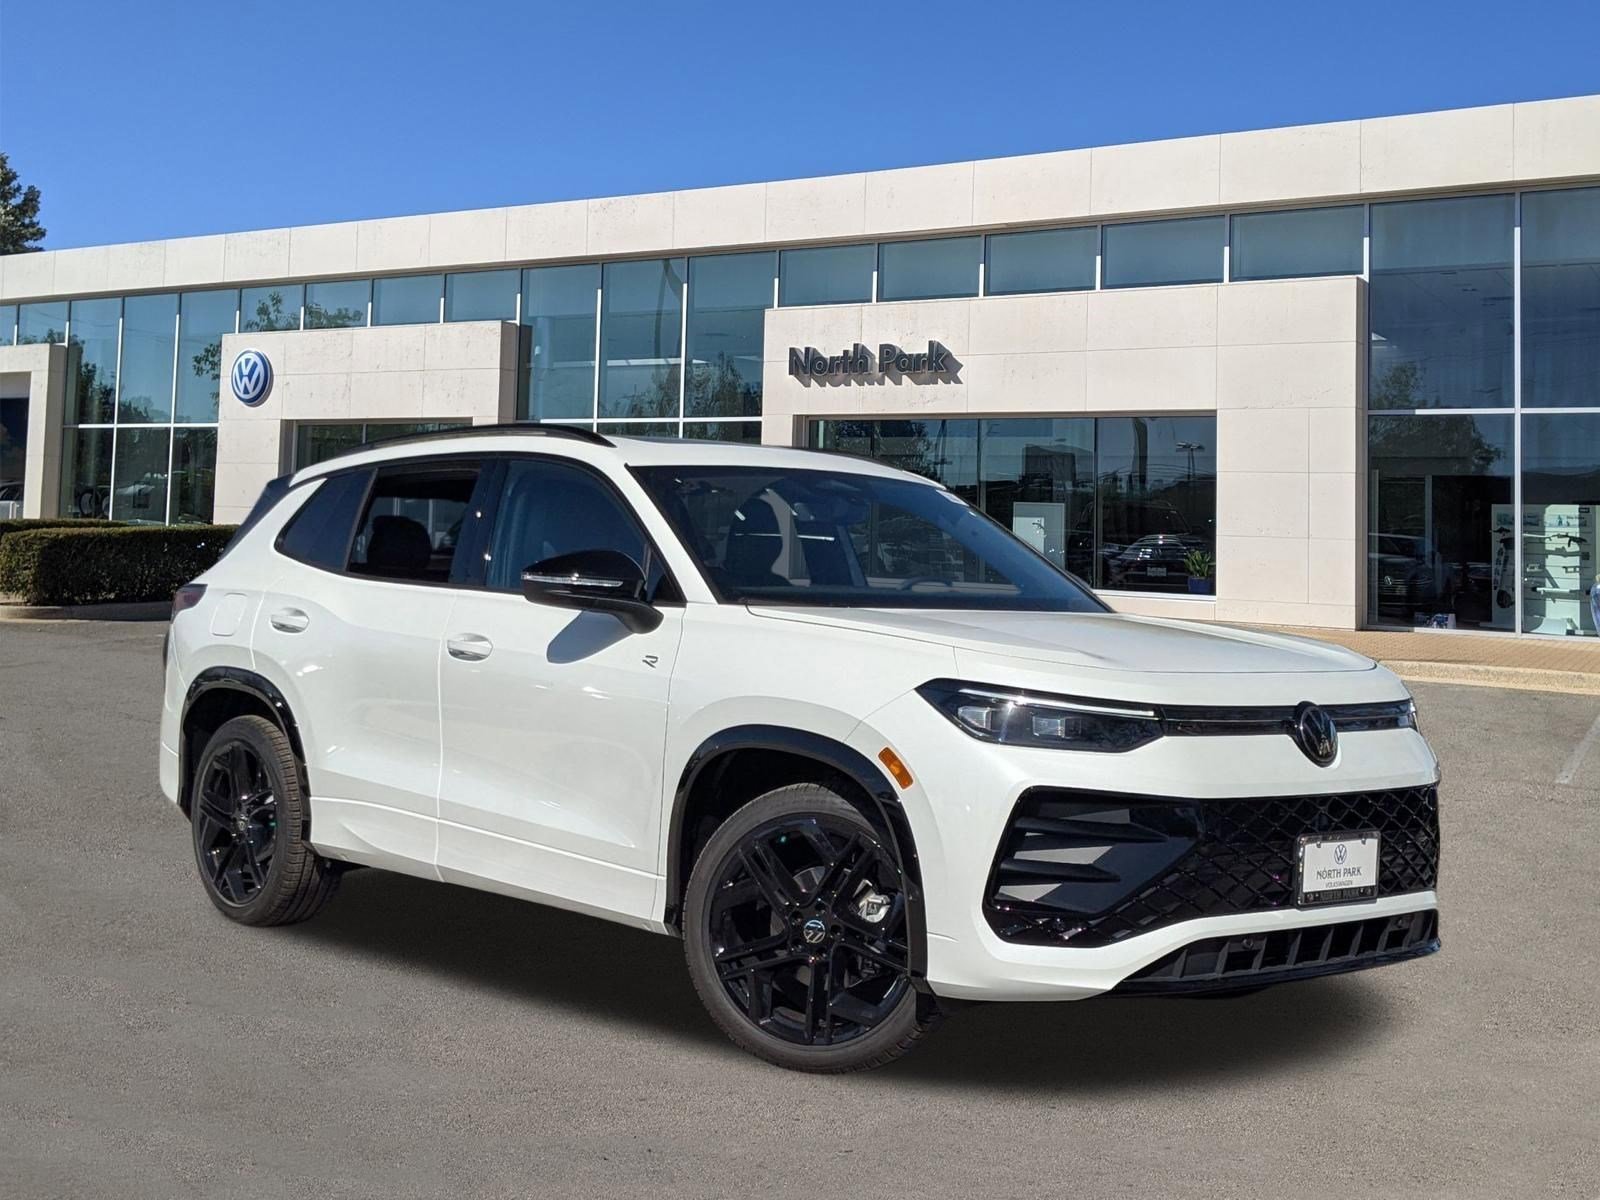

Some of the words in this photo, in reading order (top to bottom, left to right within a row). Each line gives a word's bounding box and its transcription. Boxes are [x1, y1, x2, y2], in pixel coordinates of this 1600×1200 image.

[788, 343, 871, 375] North
[878, 340, 947, 373] Park
[232, 351, 268, 403] VW
[1316, 868, 1342, 880] NORTH
[1343, 866, 1362, 878] PARK
